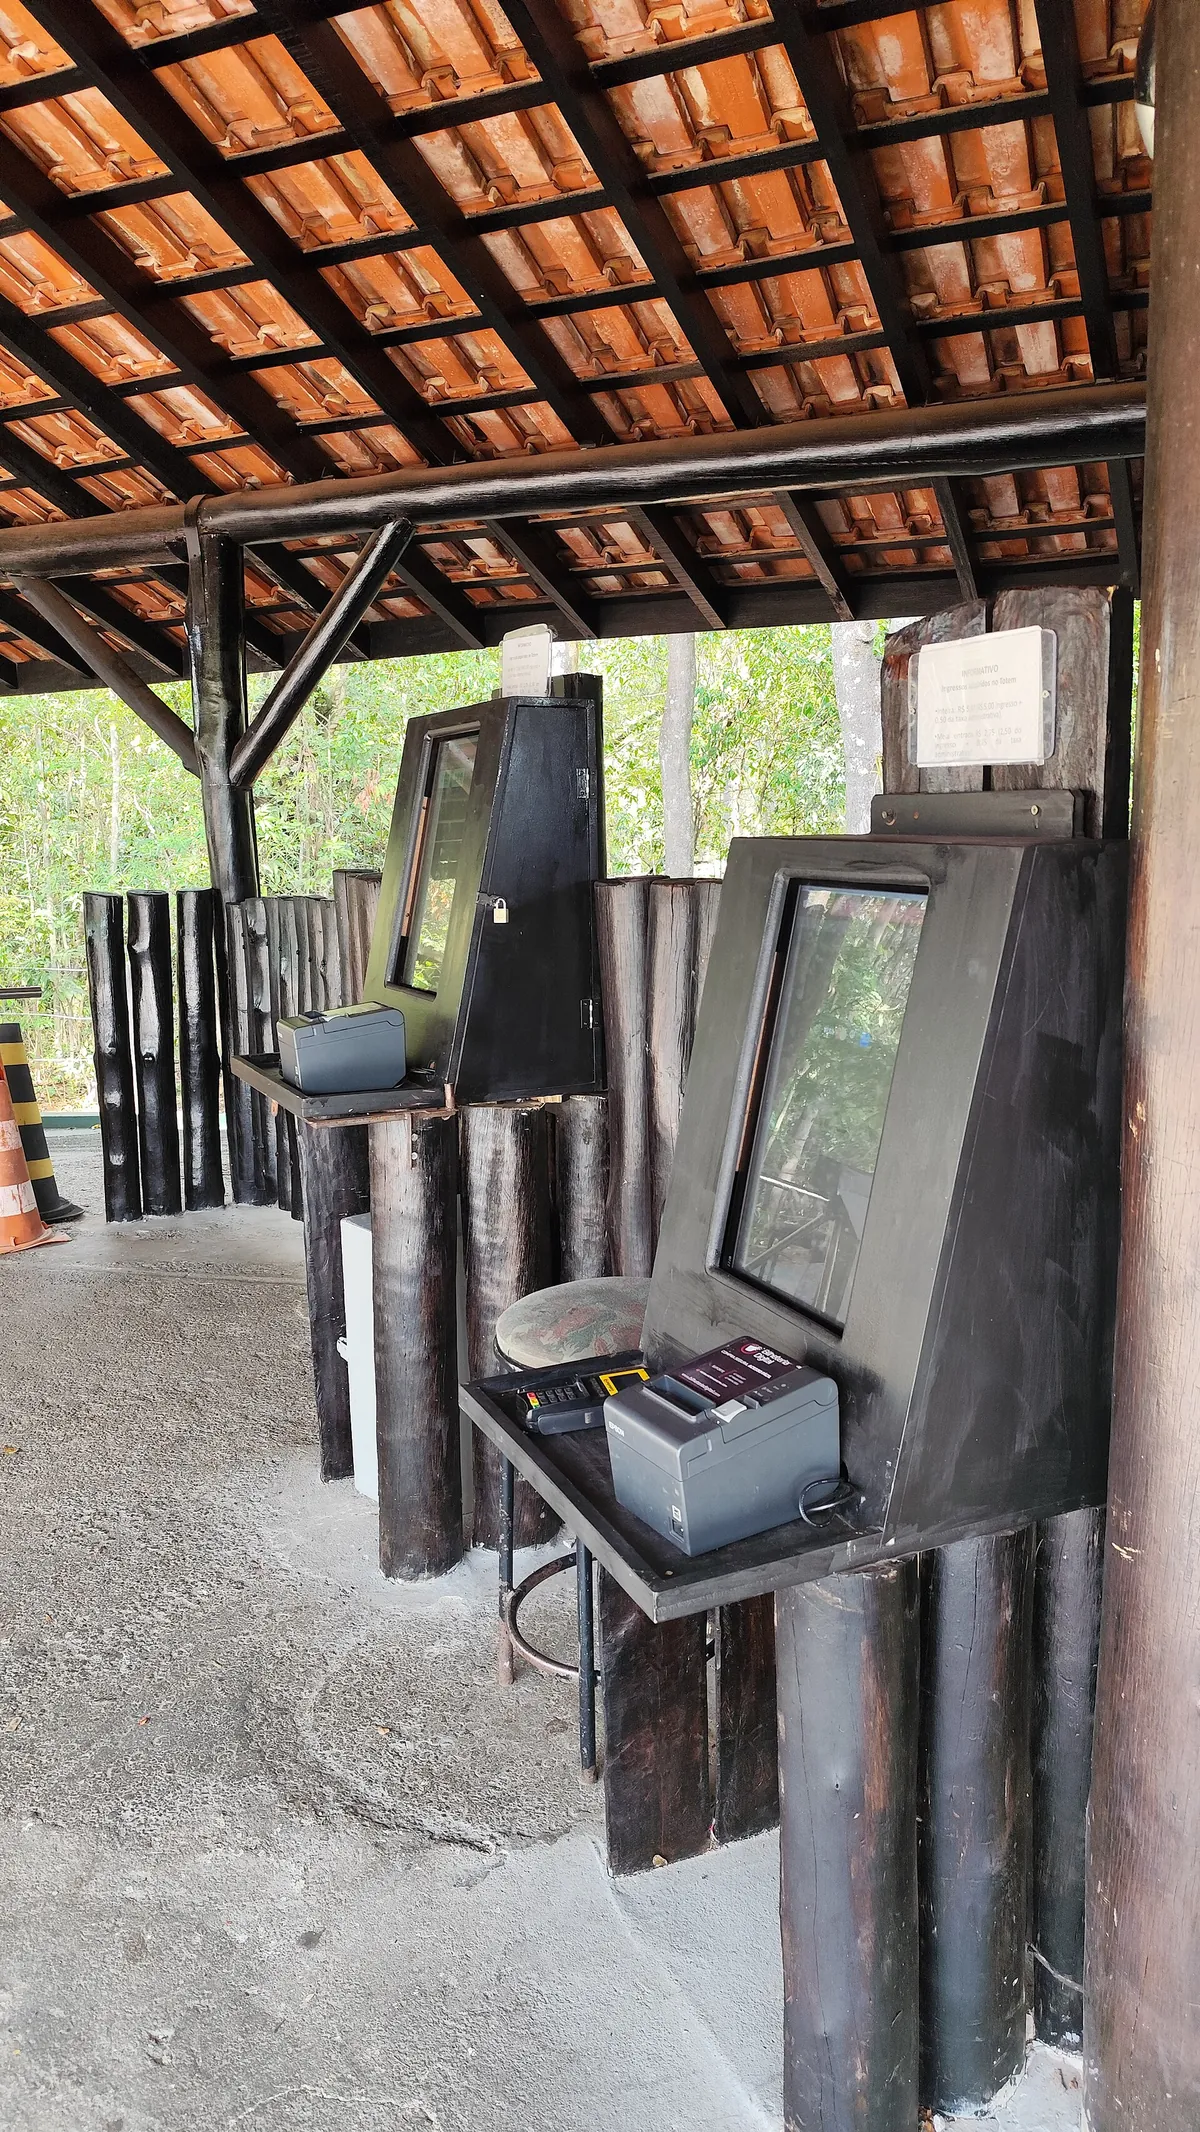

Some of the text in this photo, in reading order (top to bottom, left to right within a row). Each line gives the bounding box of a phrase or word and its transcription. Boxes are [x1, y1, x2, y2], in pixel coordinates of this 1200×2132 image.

[961, 664, 999, 678] INFORMATIVO
[753, 1352, 775, 1365] Digital
[608, 1420, 625, 1438] EPSON
